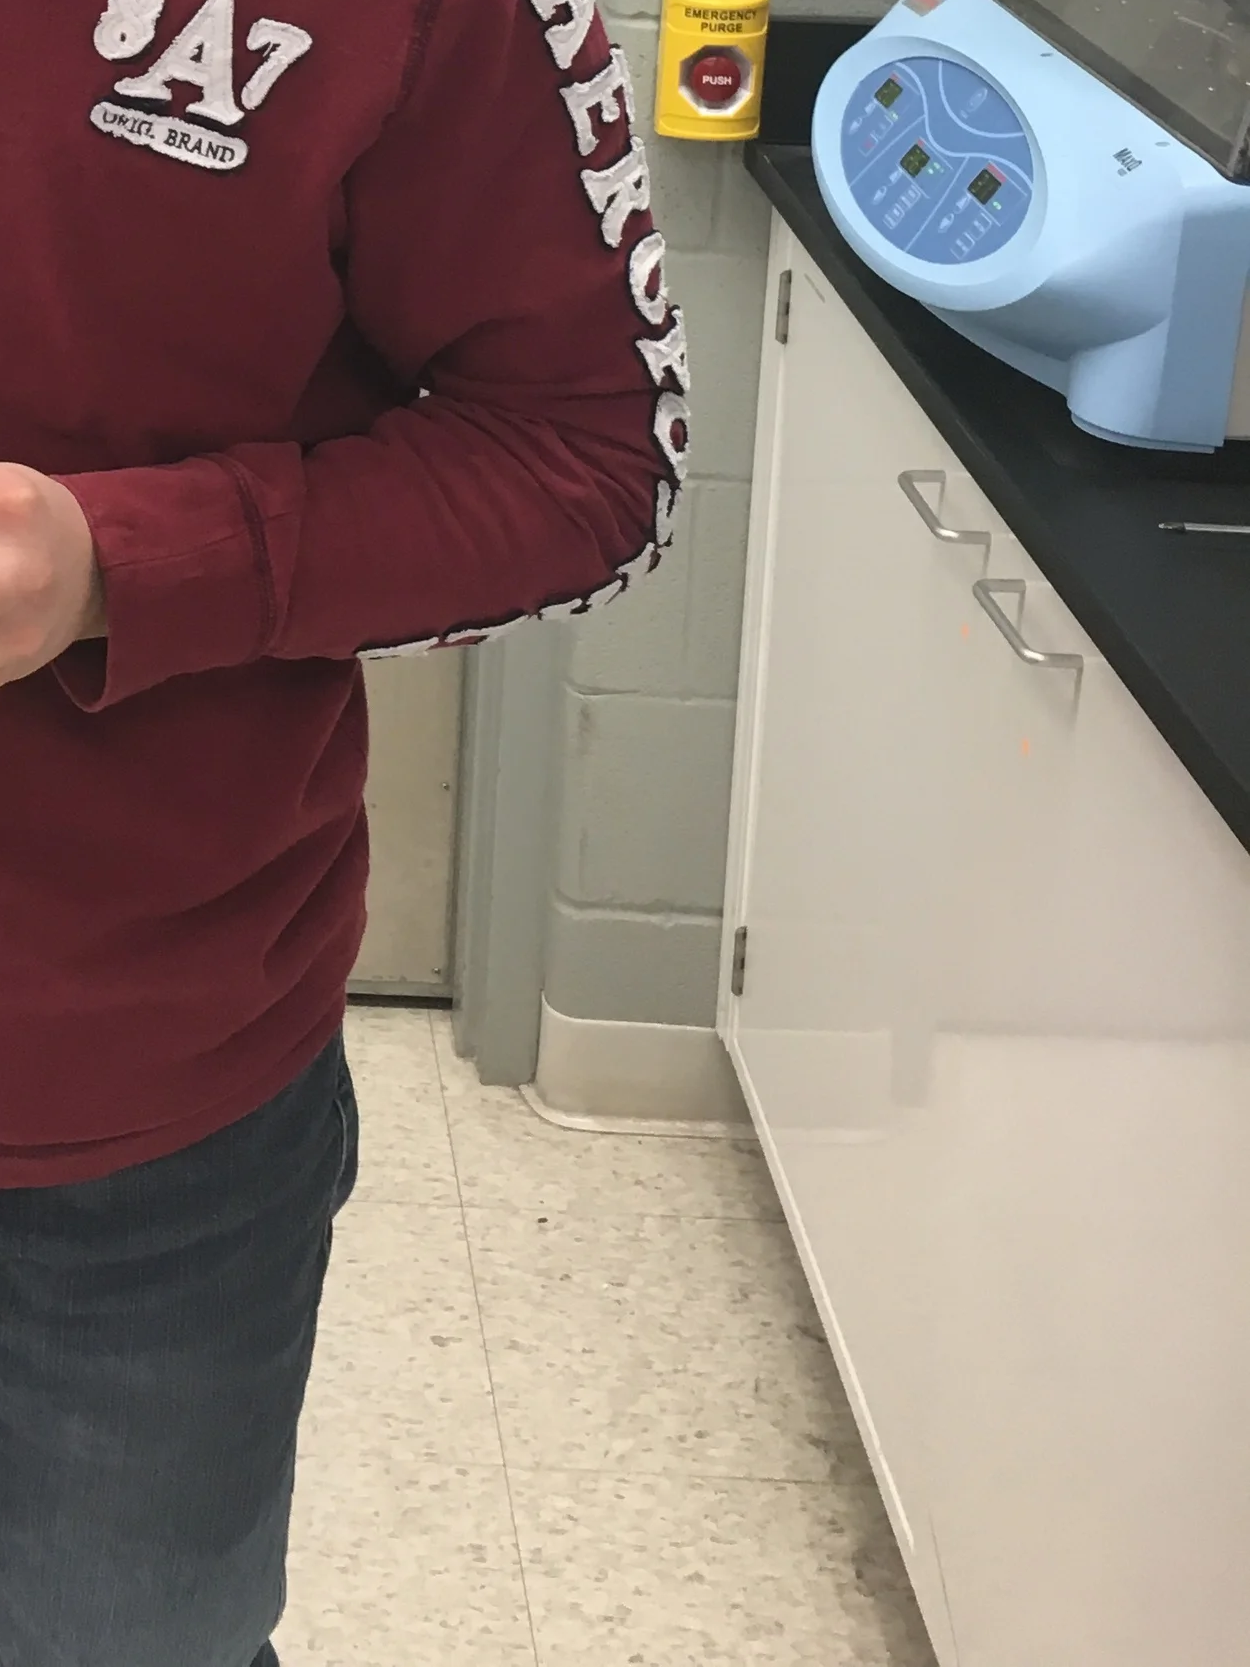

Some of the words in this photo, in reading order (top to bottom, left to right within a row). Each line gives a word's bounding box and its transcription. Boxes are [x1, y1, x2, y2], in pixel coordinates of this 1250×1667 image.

[684, 6, 759, 22] EMERGENCY
[700, 21, 744, 34] PURGE
[702, 74, 733, 86] PUSH
[163, 128, 237, 164] BRAND
